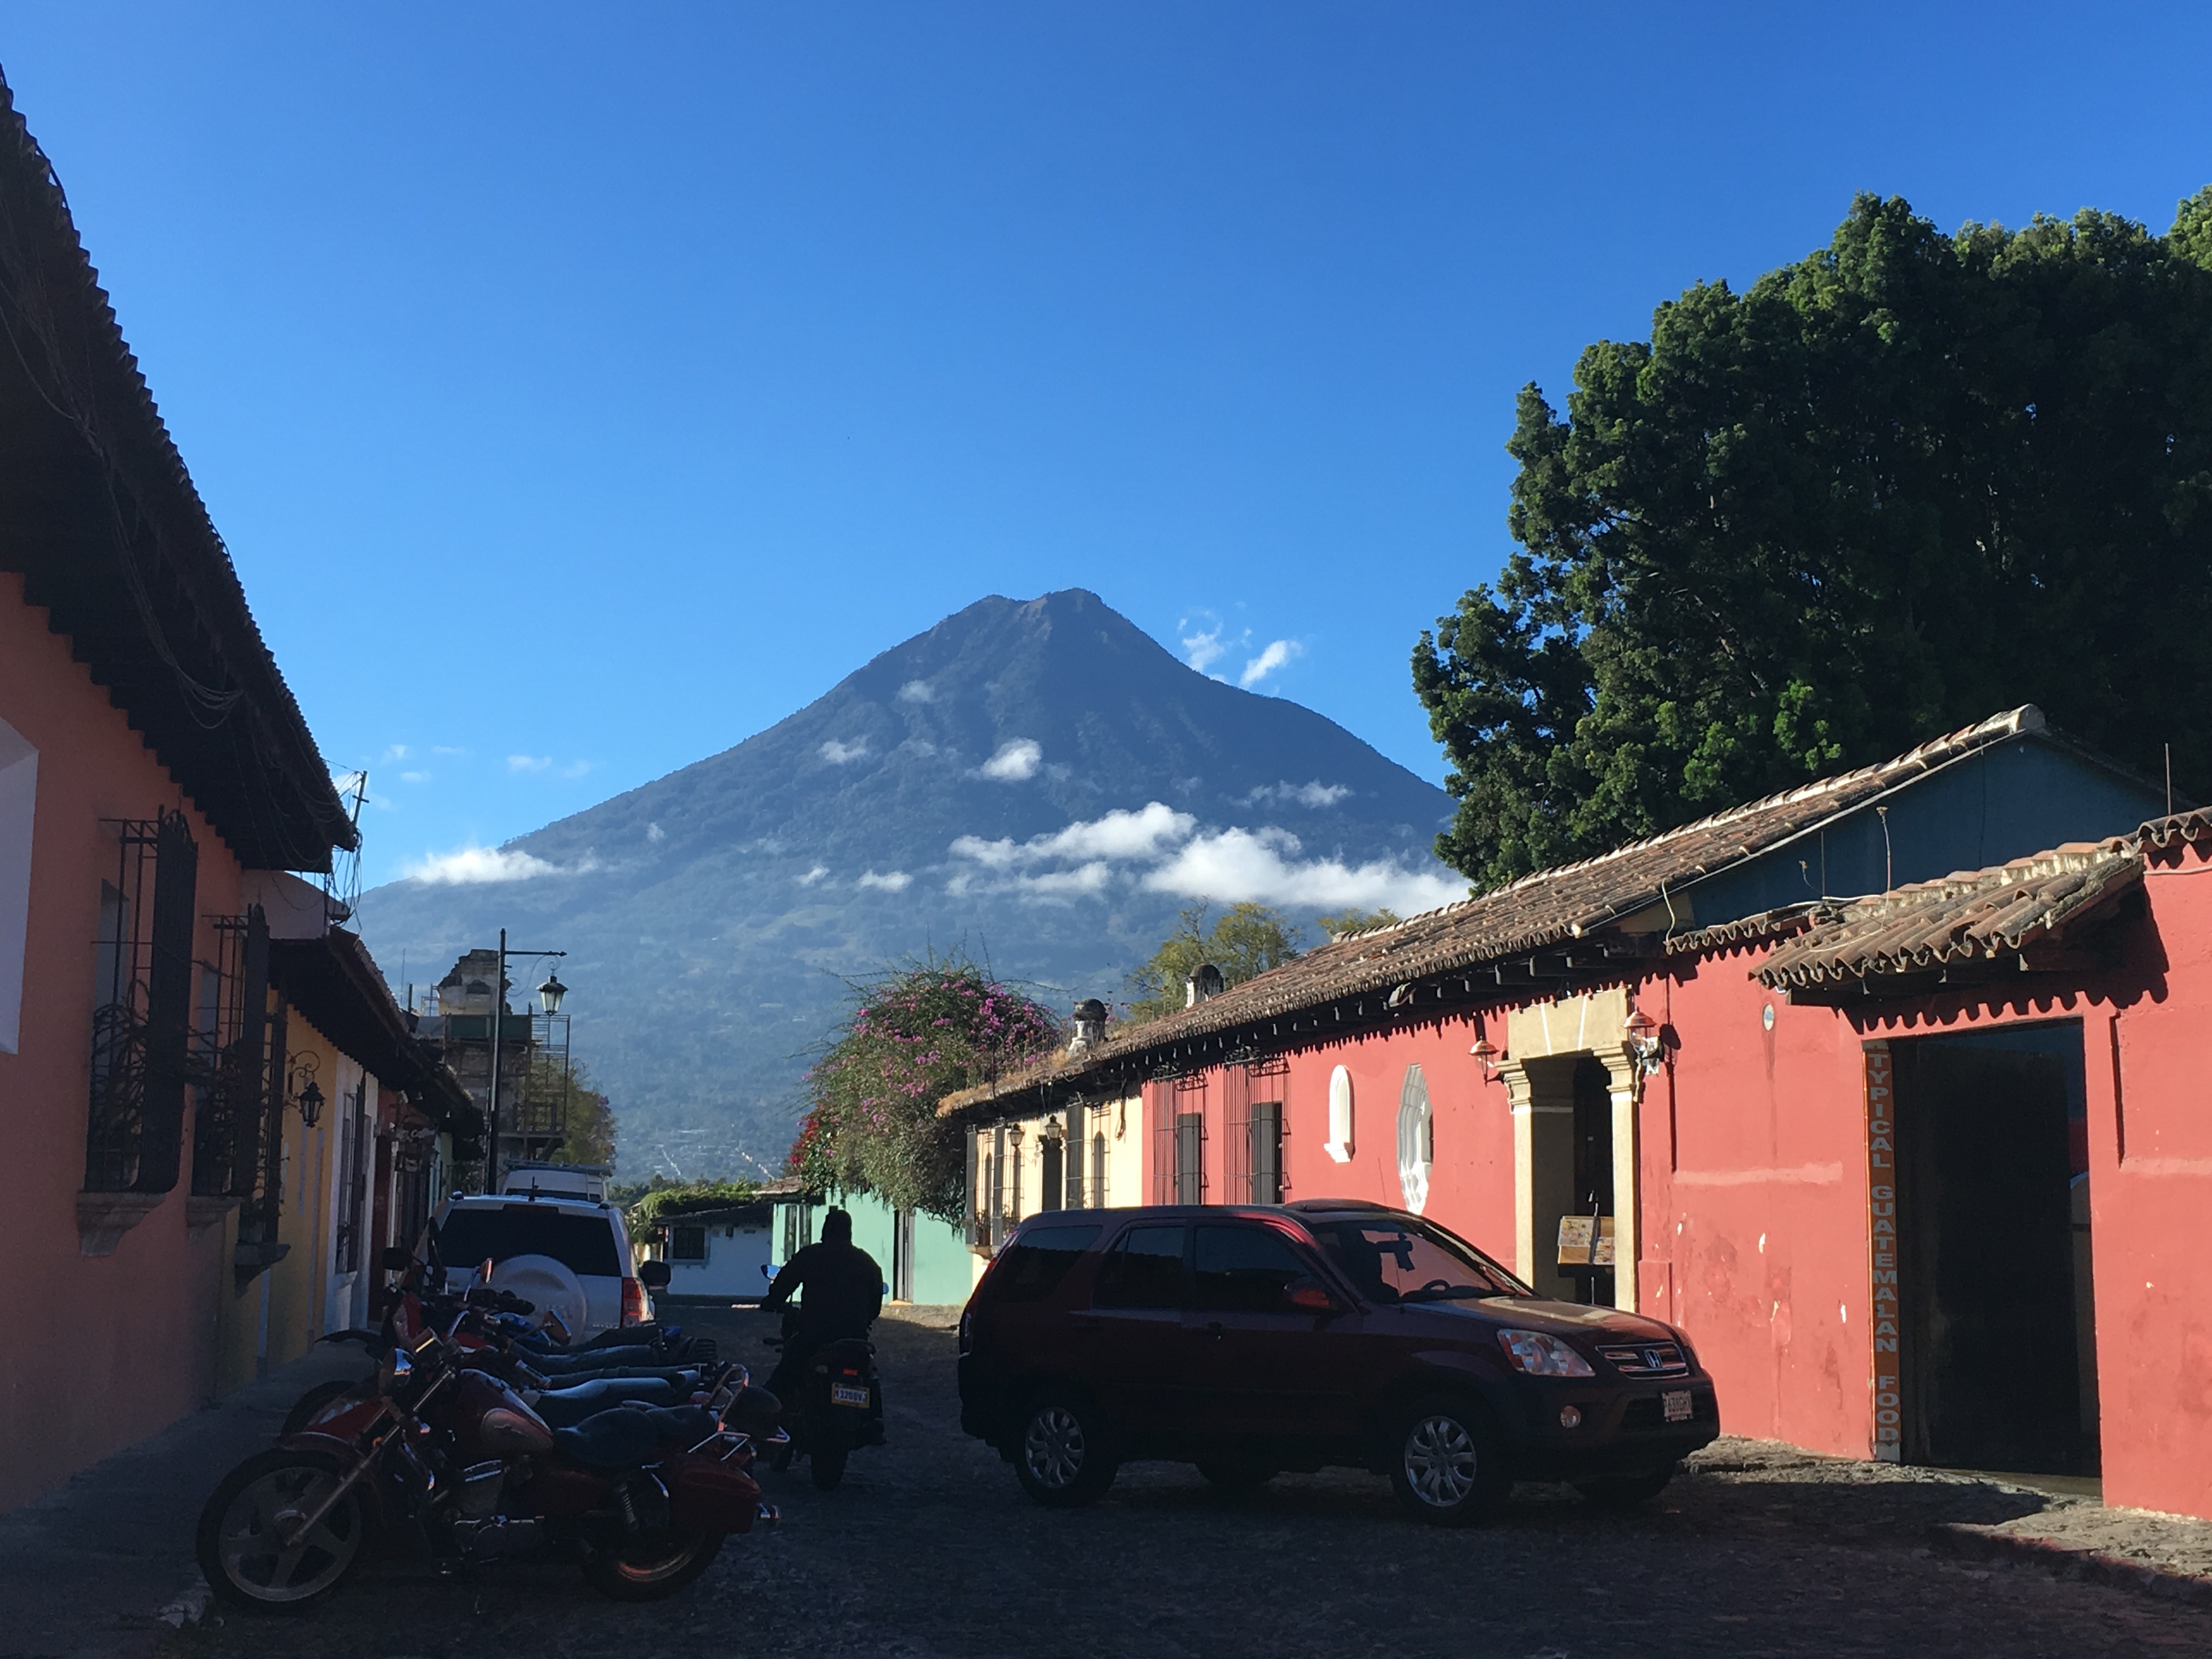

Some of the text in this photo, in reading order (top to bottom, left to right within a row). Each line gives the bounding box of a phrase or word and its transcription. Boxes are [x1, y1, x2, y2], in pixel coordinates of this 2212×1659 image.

[1867, 1053, 1899, 1441] TYPICAL GUATEMALAN FOOD
